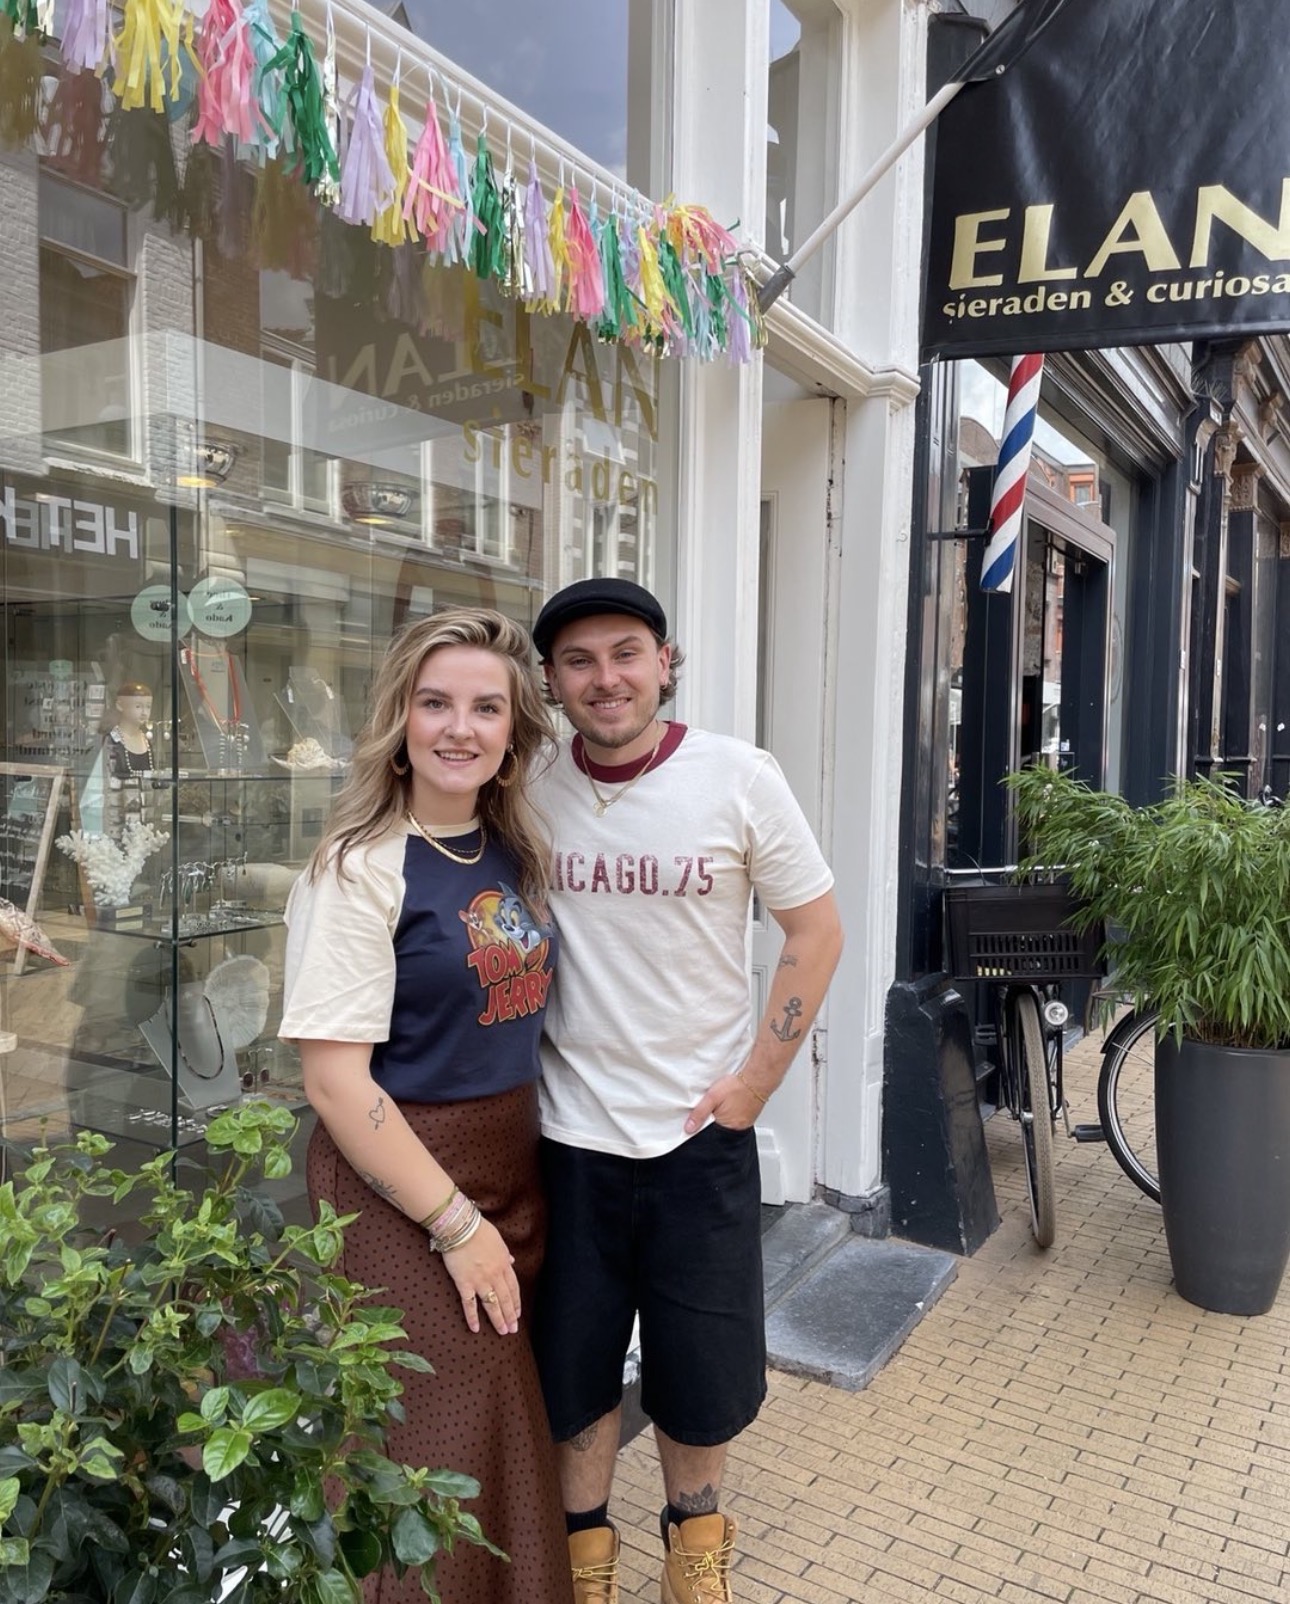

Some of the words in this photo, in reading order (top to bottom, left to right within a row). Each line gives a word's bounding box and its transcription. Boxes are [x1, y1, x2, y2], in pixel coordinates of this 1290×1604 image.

[949, 177, 1290, 290] ELAN
[942, 286, 1092, 320] sieraden
[1104, 281, 1134, 307] &
[551, 852, 714, 897] ICAGO.75
[467, 938, 523, 989] TOM
[478, 968, 554, 1027] JERRY
